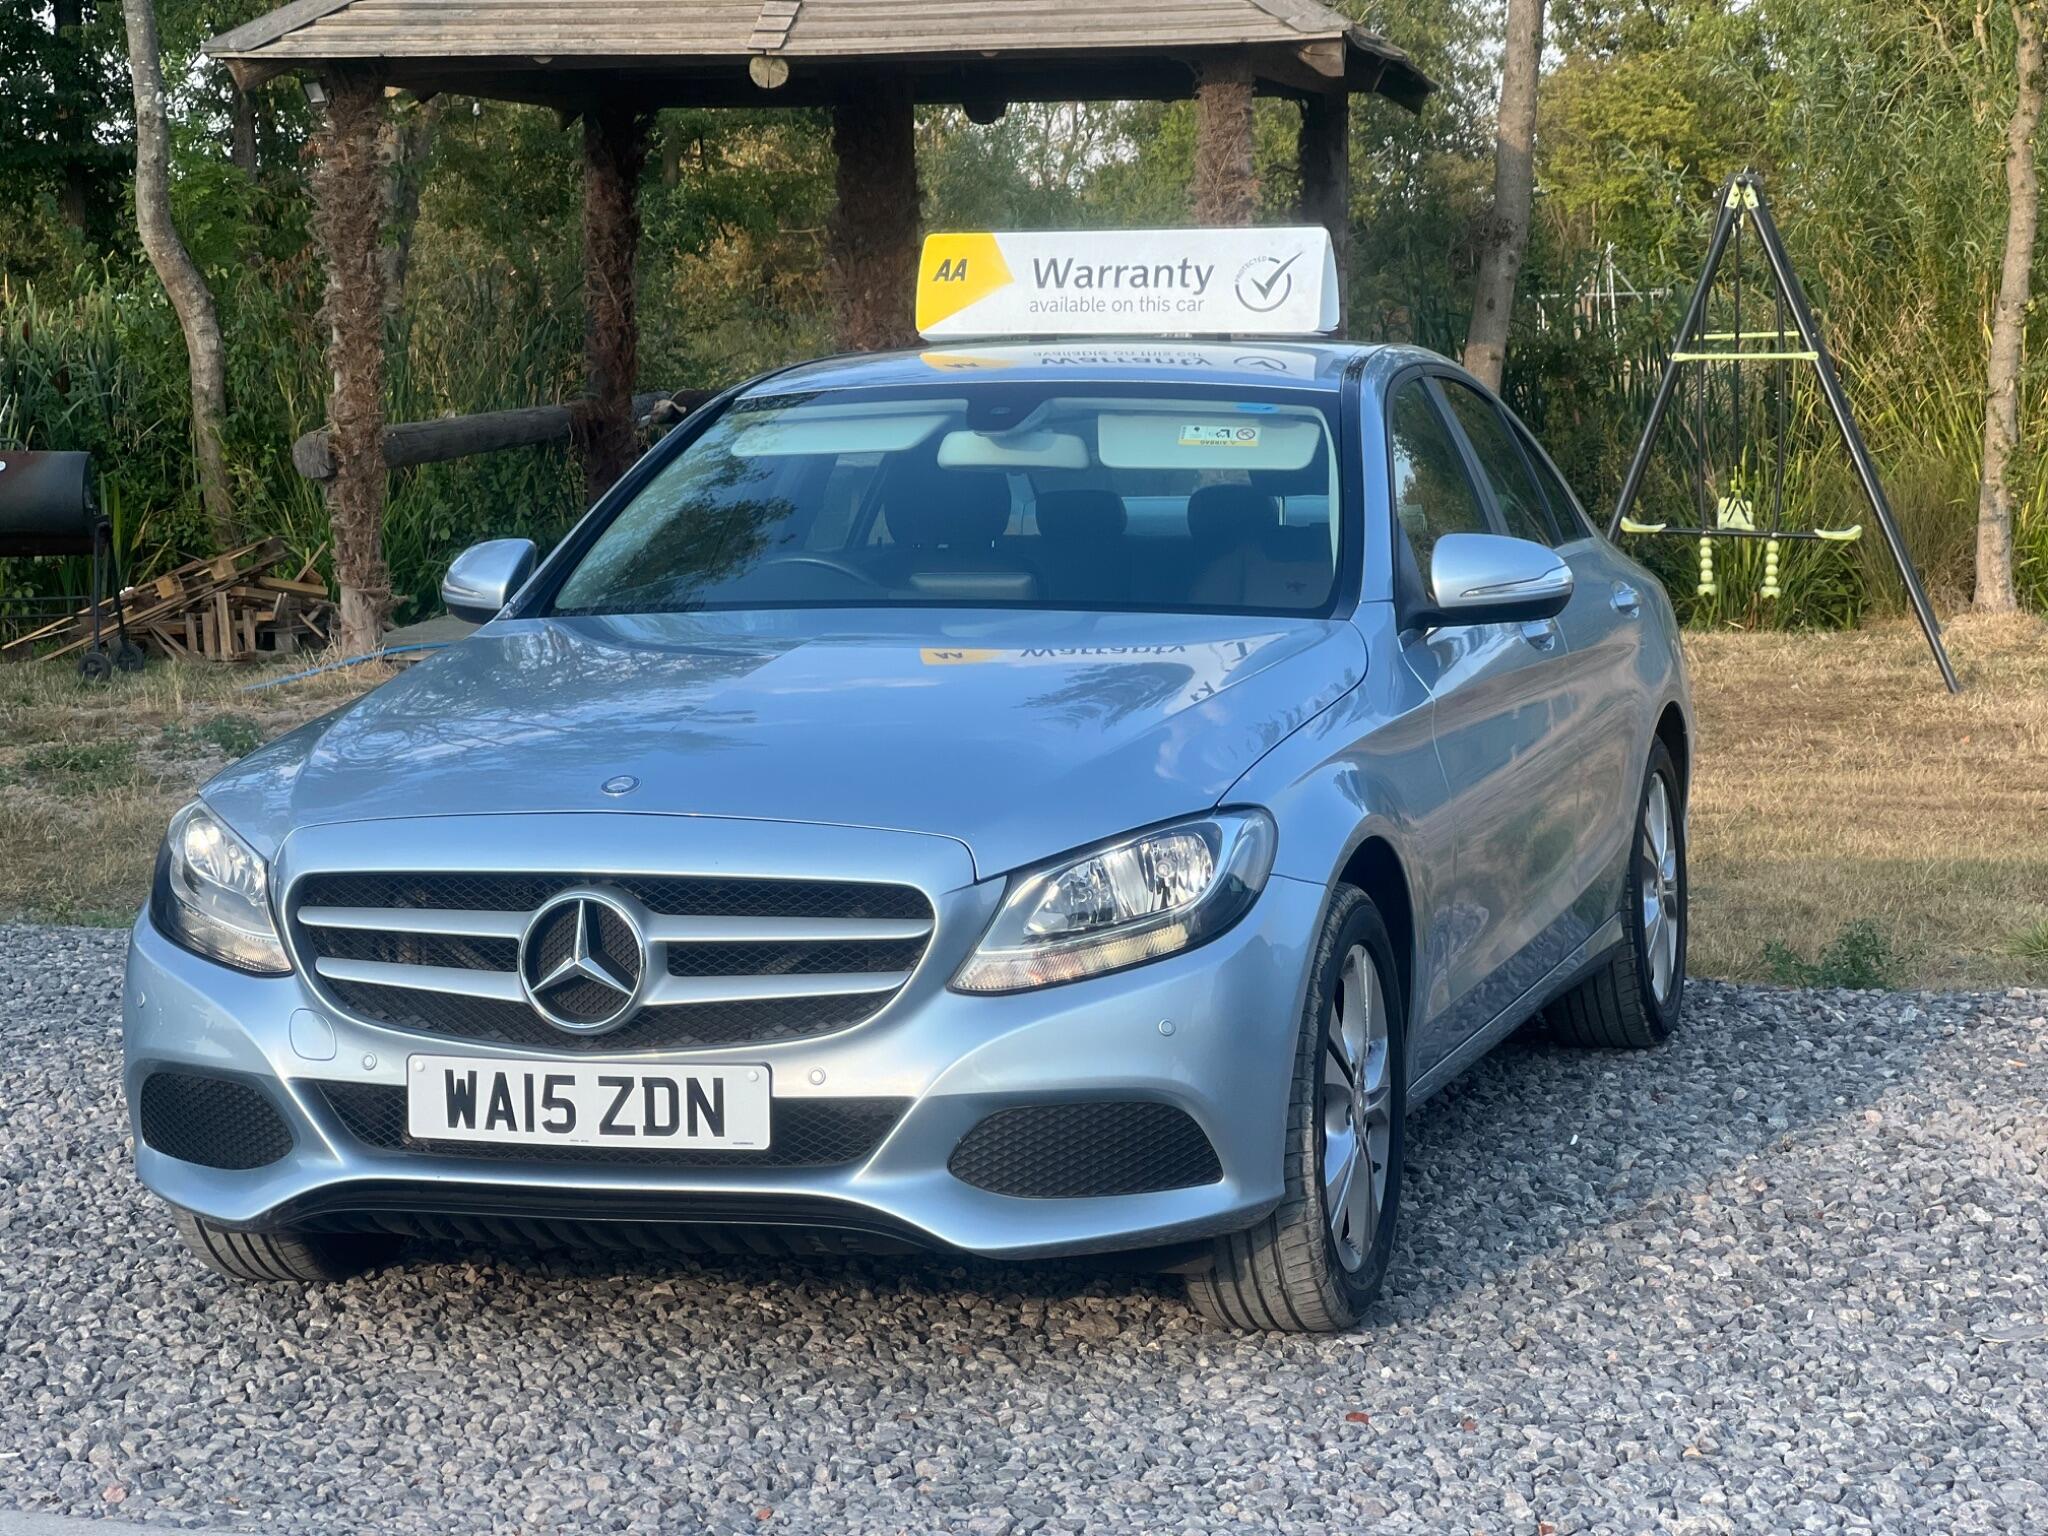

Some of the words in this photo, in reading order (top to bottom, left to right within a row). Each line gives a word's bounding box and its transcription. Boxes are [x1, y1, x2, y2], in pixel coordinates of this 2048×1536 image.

[933, 258, 967, 281] AA
[1033, 257, 1215, 295] Warranty
[1029, 295, 1106, 313] available
[1111, 299, 1133, 312] on
[1139, 295, 1170, 312] this
[1176, 299, 1206, 312] car
[444, 1069, 577, 1134] WA15
[598, 1076, 725, 1138] ZDN
